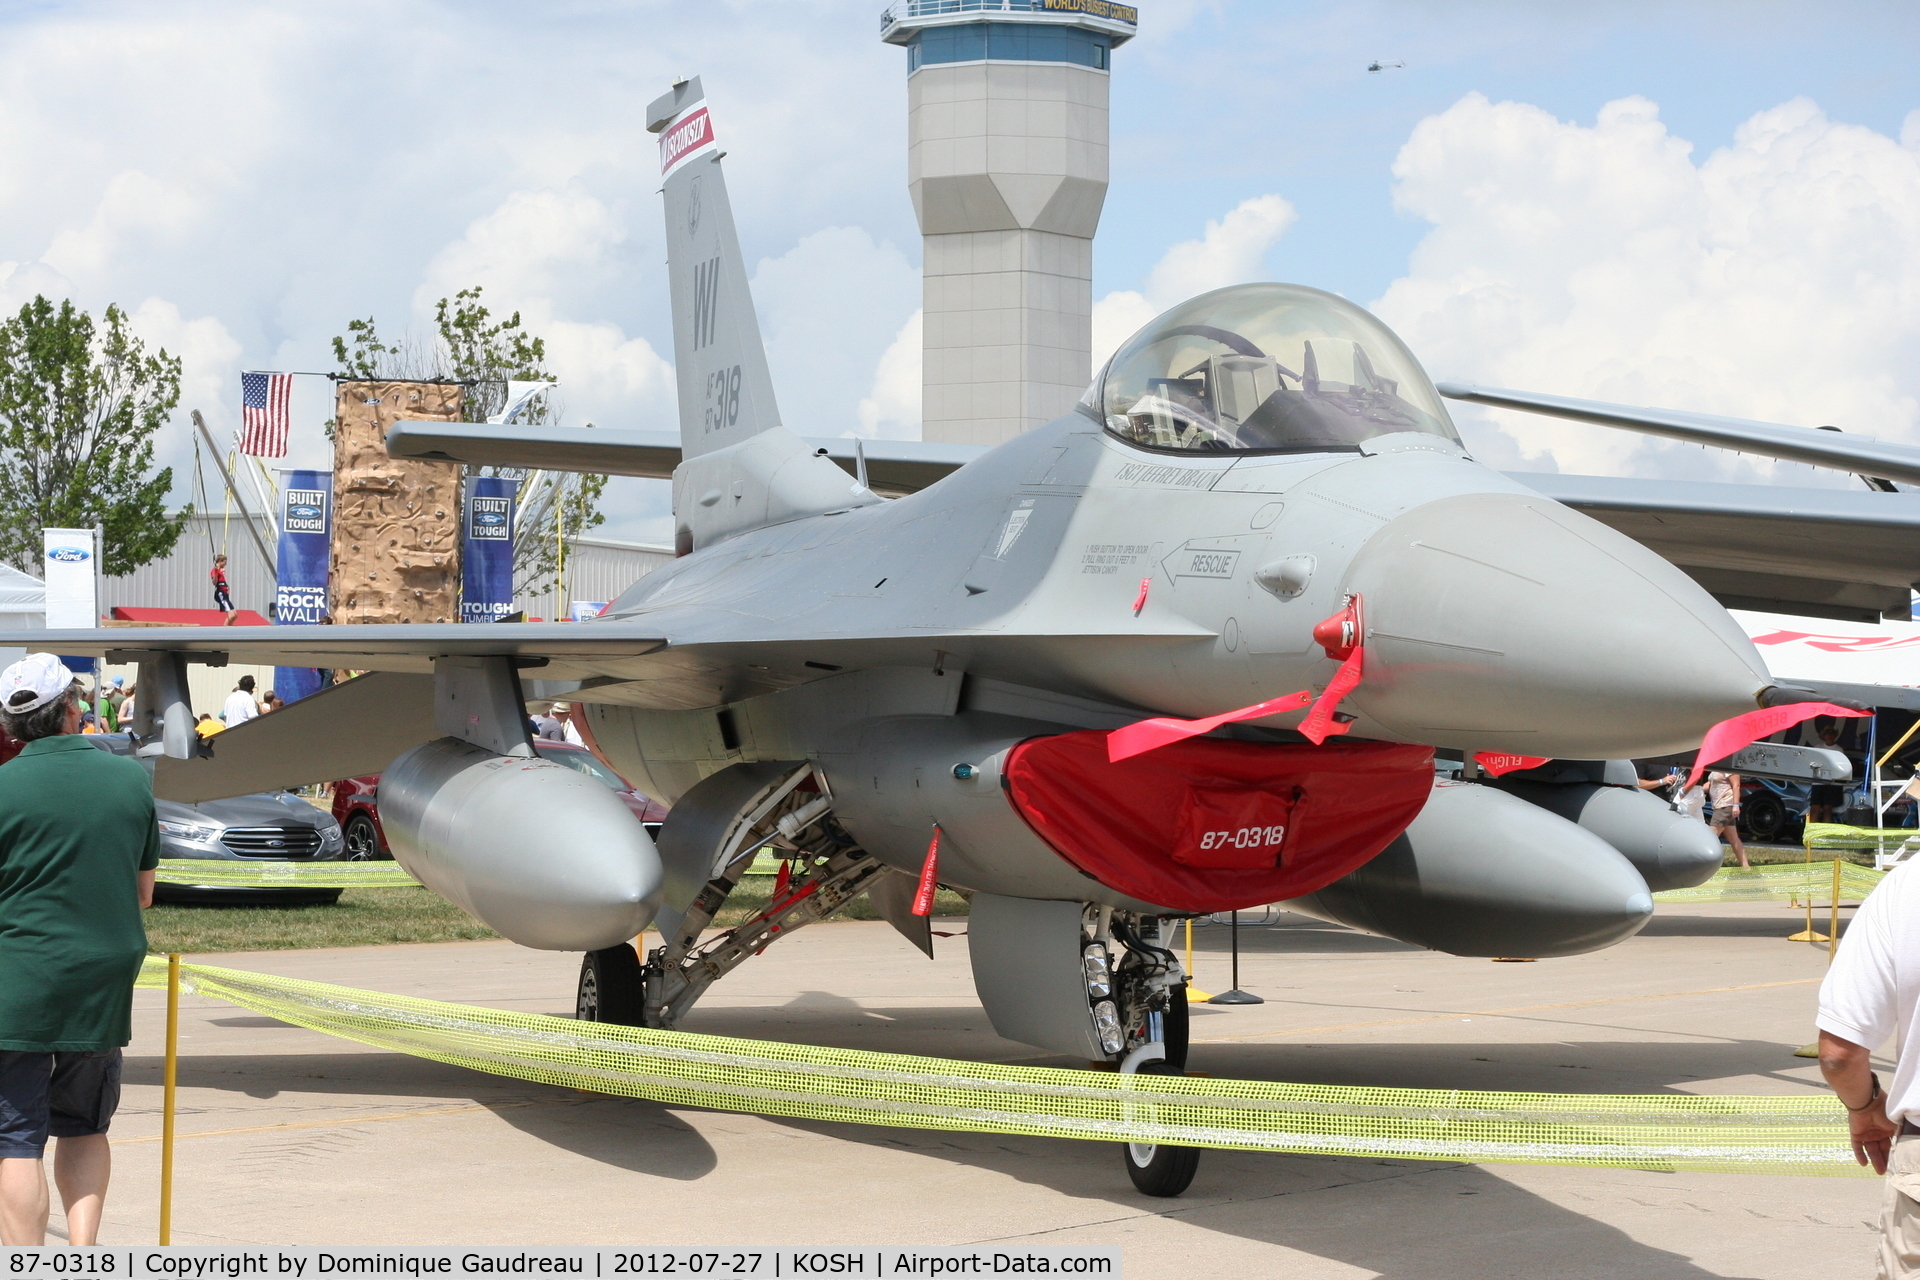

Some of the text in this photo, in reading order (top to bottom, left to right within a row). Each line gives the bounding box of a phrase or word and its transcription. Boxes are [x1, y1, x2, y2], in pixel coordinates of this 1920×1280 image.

[1086, 0, 1110, 16] BUSIEST
[660, 113, 708, 173] WISCONSIN
[694, 256, 720, 351] WI
[706, 372, 715, 400] AF
[714, 365, 742, 430] 318
[705, 408, 713, 434] 87
[1131, 464, 1182, 487] JEFFREY
[1175, 469, 1219, 490] BRAUN
[288, 492, 323, 505] BUILT
[474, 500, 508, 513] BUILT
[288, 518, 322, 530] TOUGH
[473, 526, 506, 537] TOUGH
[55, 549, 83, 561] Ford
[1190, 555, 1232, 573] RESCUE
[278, 586, 325, 595] RAPTOR
[277, 594, 325, 609] ROCK
[462, 602, 514, 615] TOUGH
[277, 607, 319, 623] WALL
[1200, 825, 1285, 850] 87-0318
